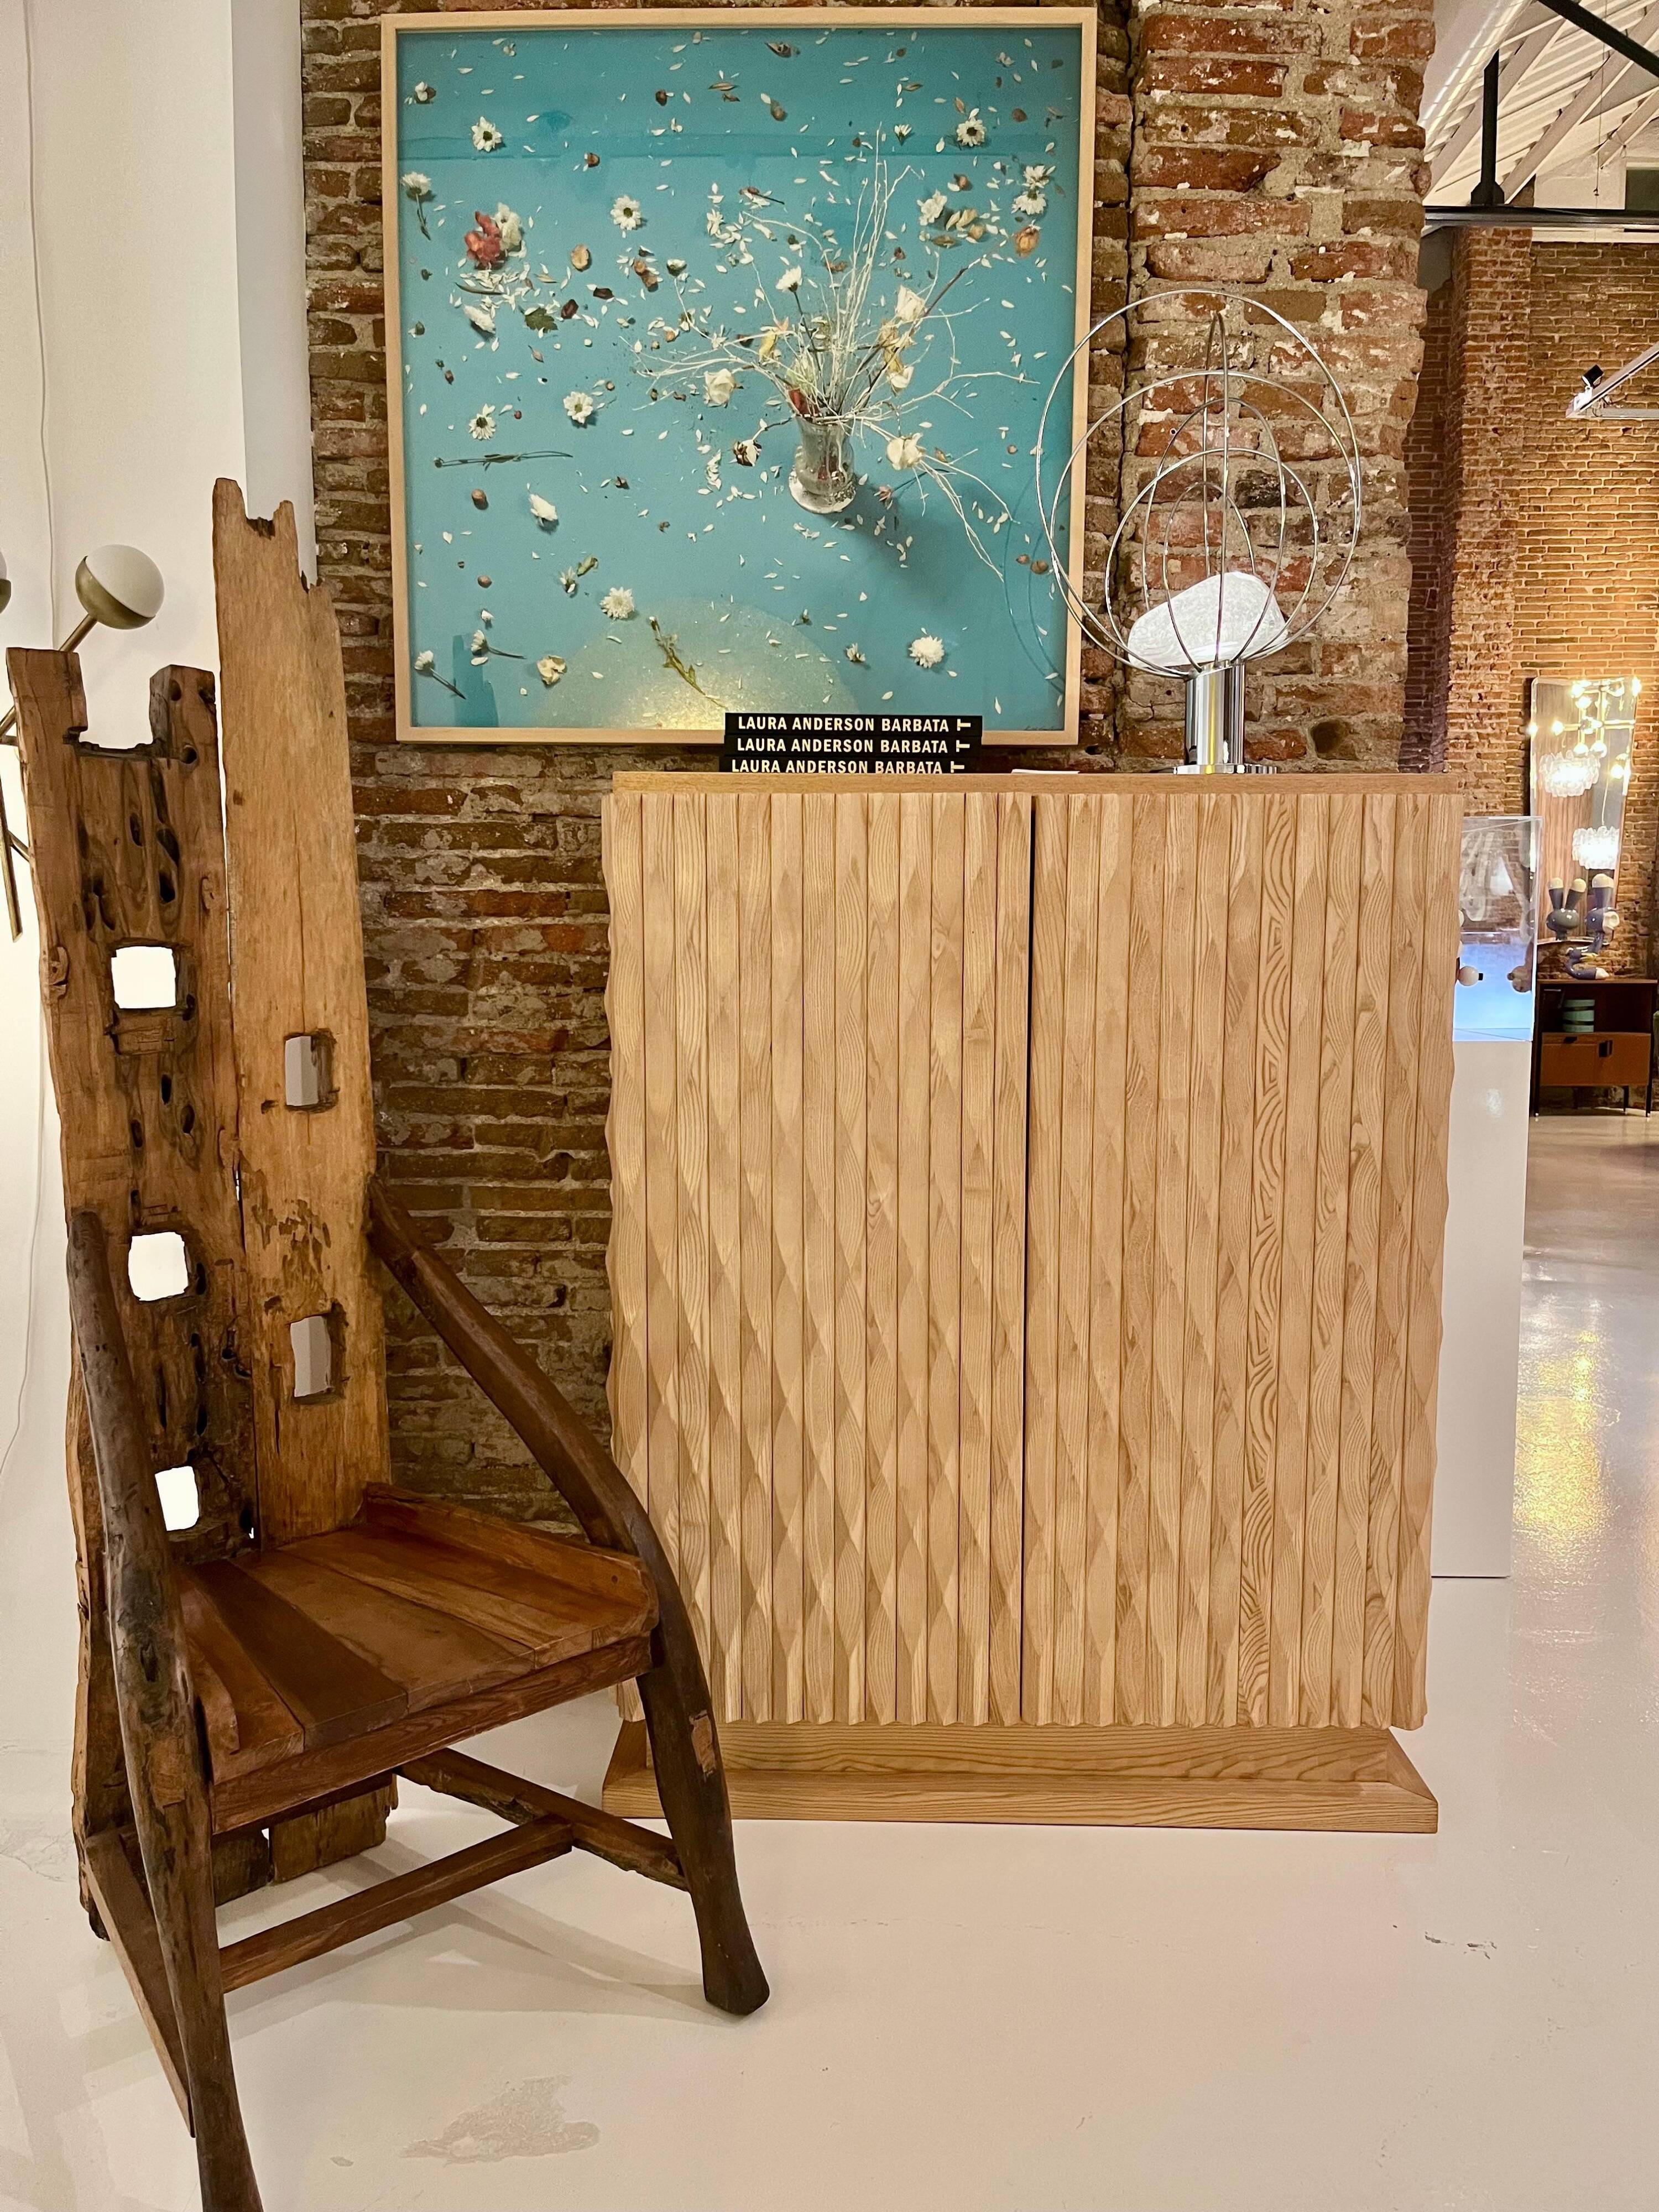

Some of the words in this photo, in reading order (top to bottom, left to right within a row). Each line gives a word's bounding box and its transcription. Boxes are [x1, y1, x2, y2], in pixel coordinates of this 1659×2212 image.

[738, 716, 787, 730] LAURA
[792, 717, 874, 731] ANDERSON
[881, 718, 949, 732] BARBATA
[737, 738, 786, 752] LAURA
[791, 738, 873, 753] ANDERSON
[880, 739, 948, 753] BARBATA
[732, 759, 781, 773] LAURA
[785, 760, 868, 774] ANDERSON
[875, 761, 943, 774] BARBATA
